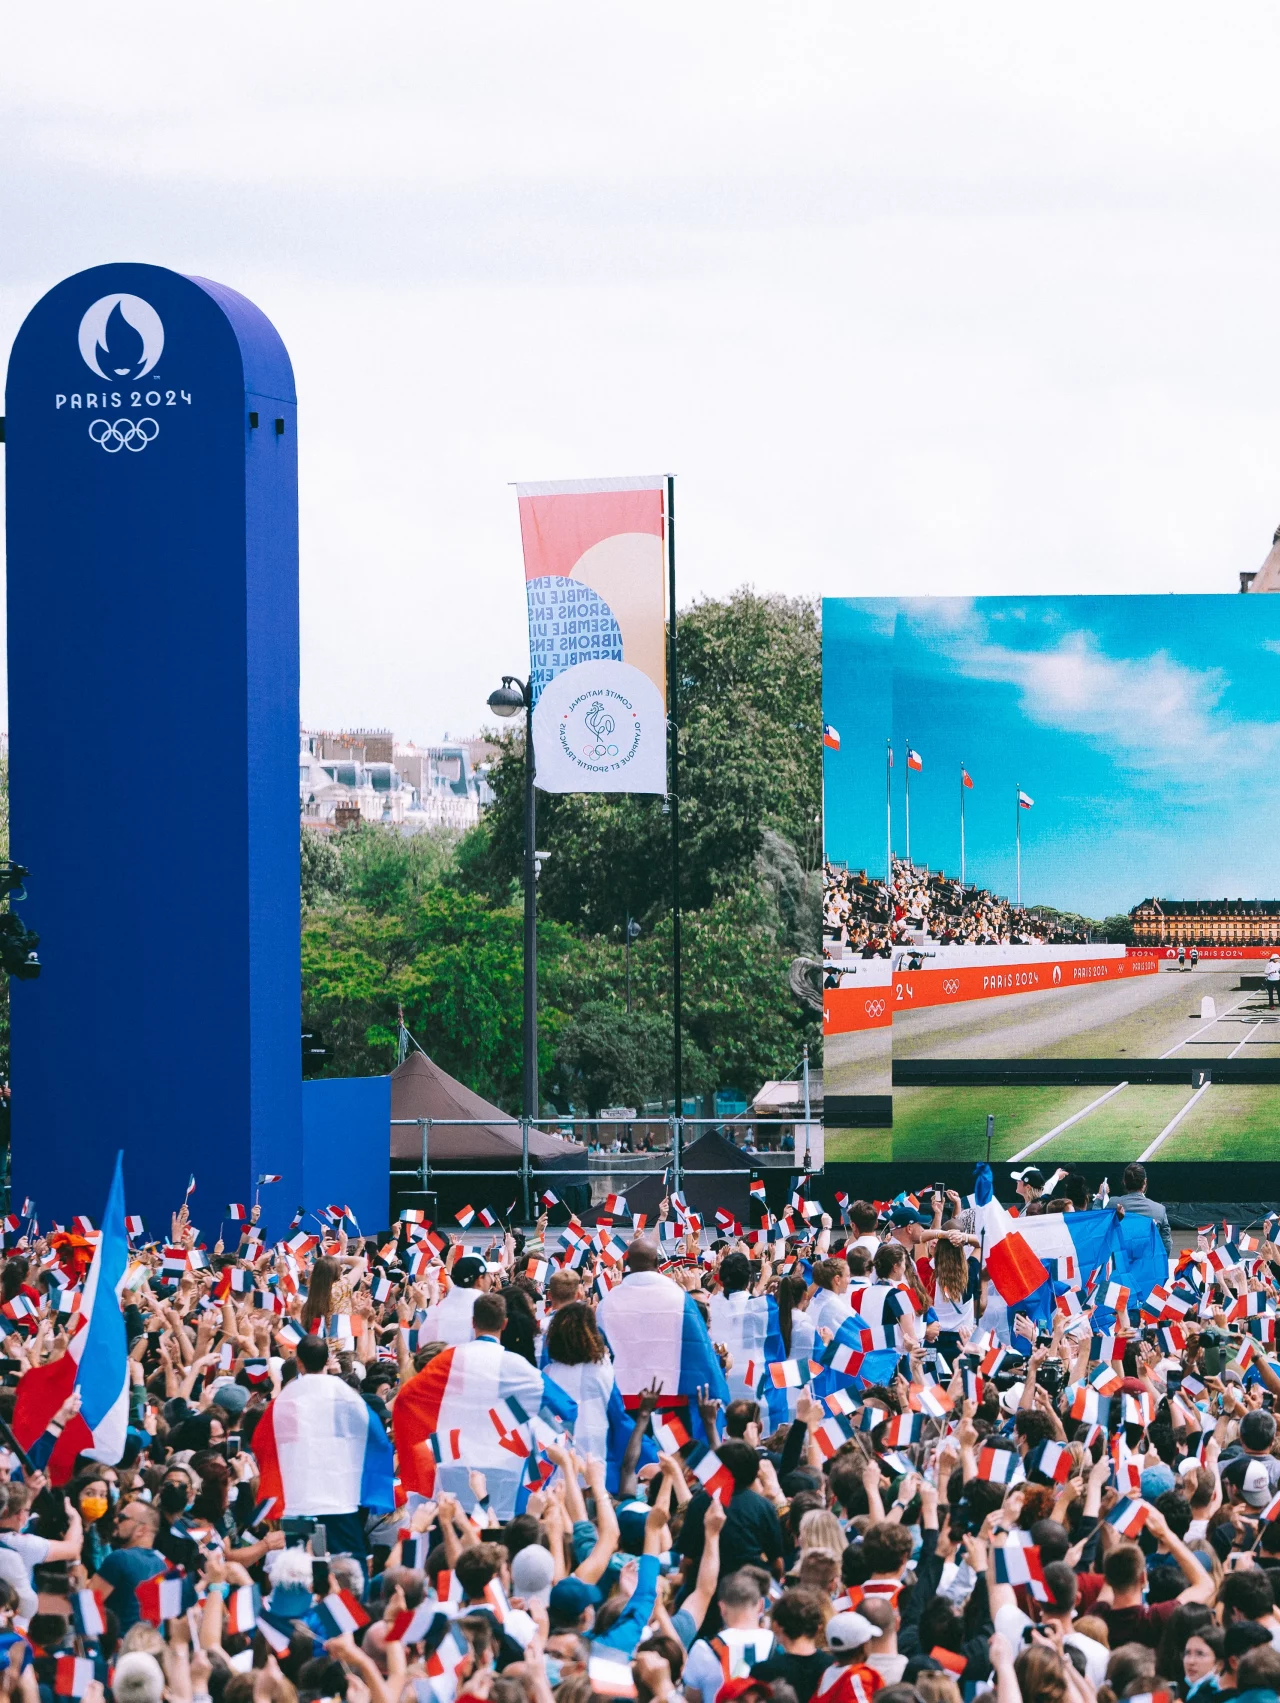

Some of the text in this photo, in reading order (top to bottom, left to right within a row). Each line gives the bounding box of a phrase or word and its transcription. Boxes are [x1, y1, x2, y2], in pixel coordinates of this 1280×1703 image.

[130, 389, 192, 407] 2024
[1093, 965, 1109, 977] 2024
[1015, 971, 1039, 987] 2024
[1199, 1072, 1205, 1086] 1
